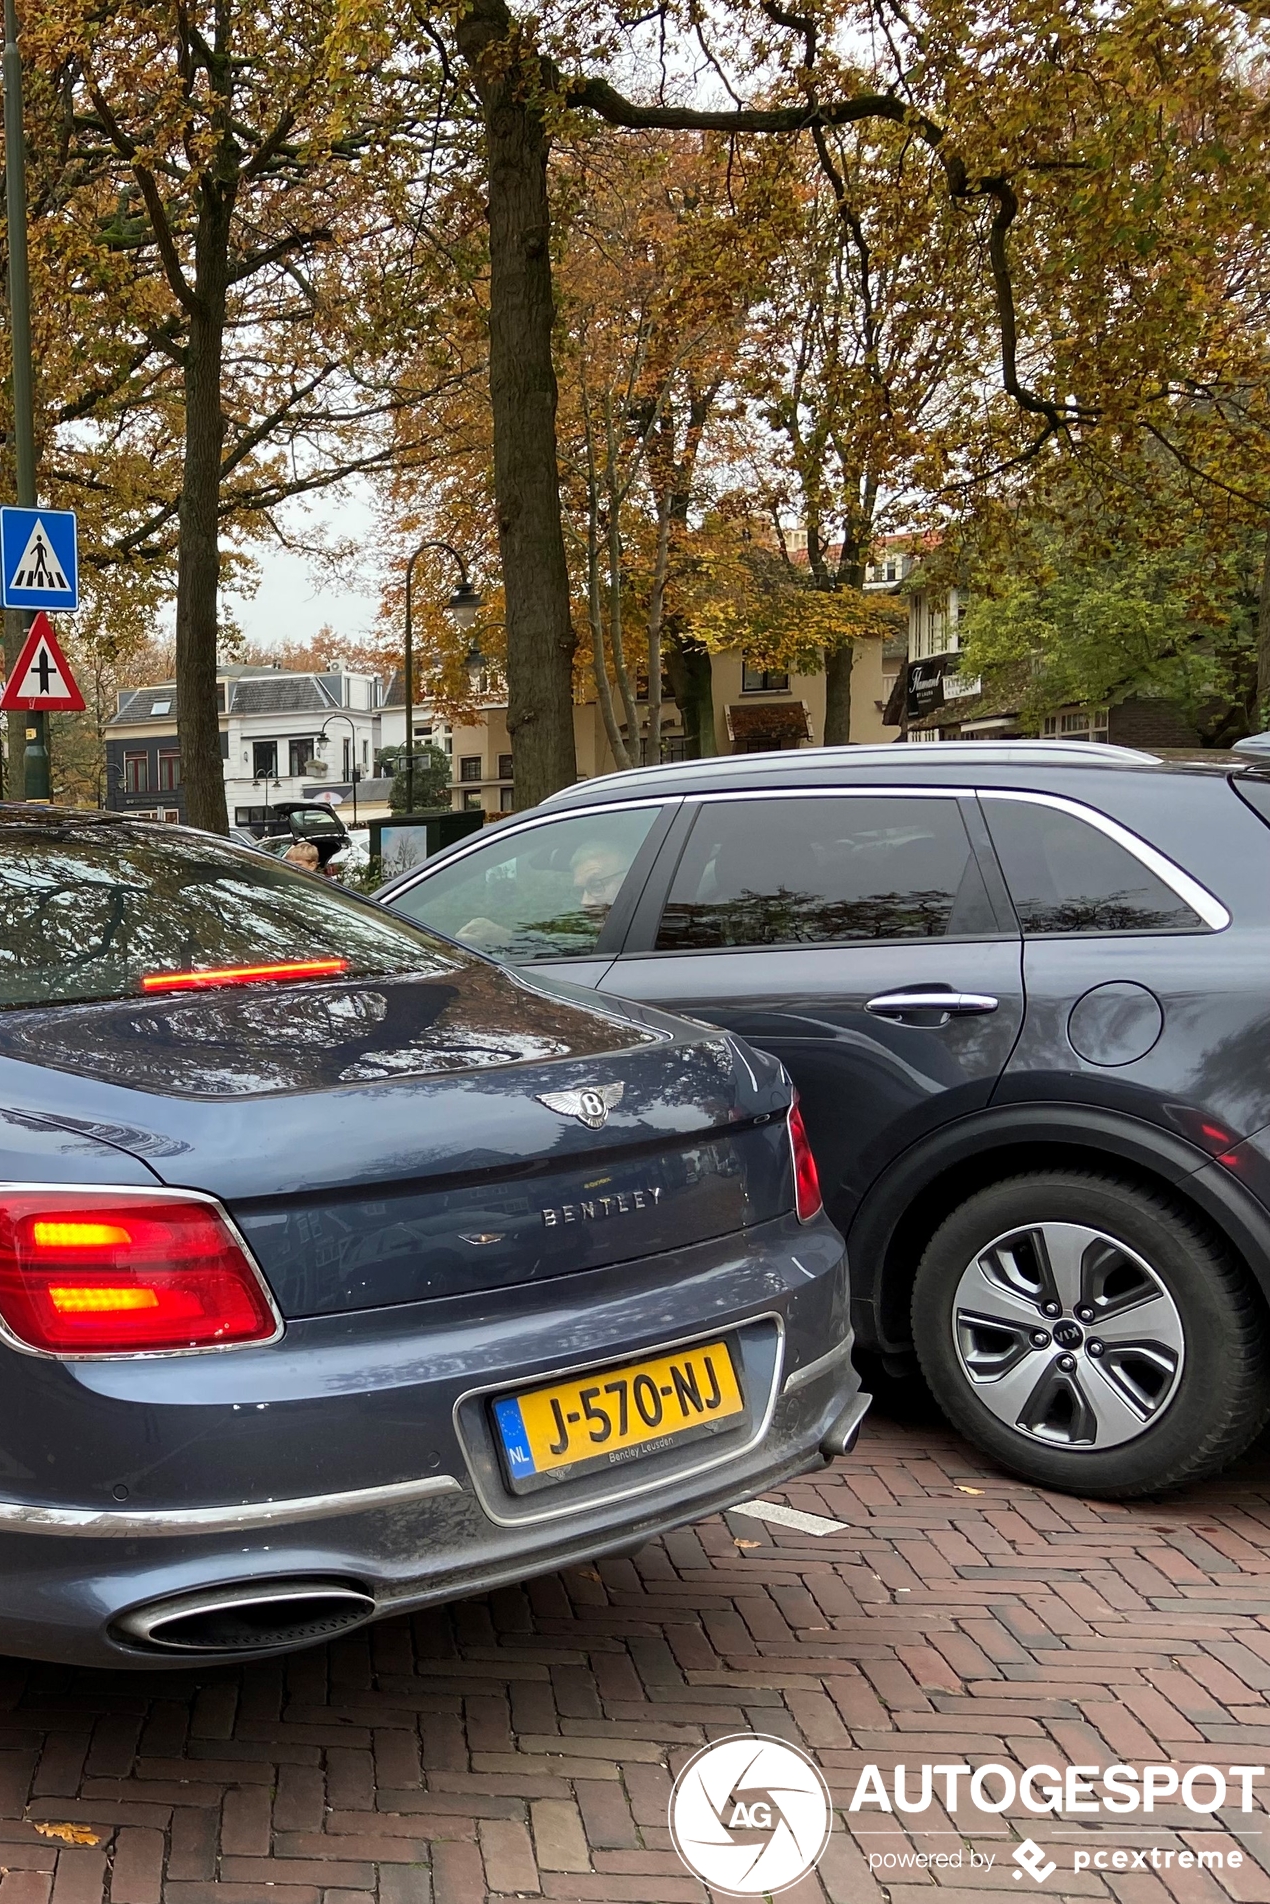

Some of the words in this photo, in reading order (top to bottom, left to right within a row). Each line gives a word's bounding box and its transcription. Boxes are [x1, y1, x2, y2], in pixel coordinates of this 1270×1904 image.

[581, 1092, 604, 1116] B
[542, 1187, 661, 1227] BENTLEY
[1054, 1326, 1080, 1342] KIA
[549, 1356, 722, 1455] J-570-NJ
[509, 1446, 530, 1466] NL
[608, 1446, 640, 1463] Bentley
[640, 1437, 674, 1454] Leusden
